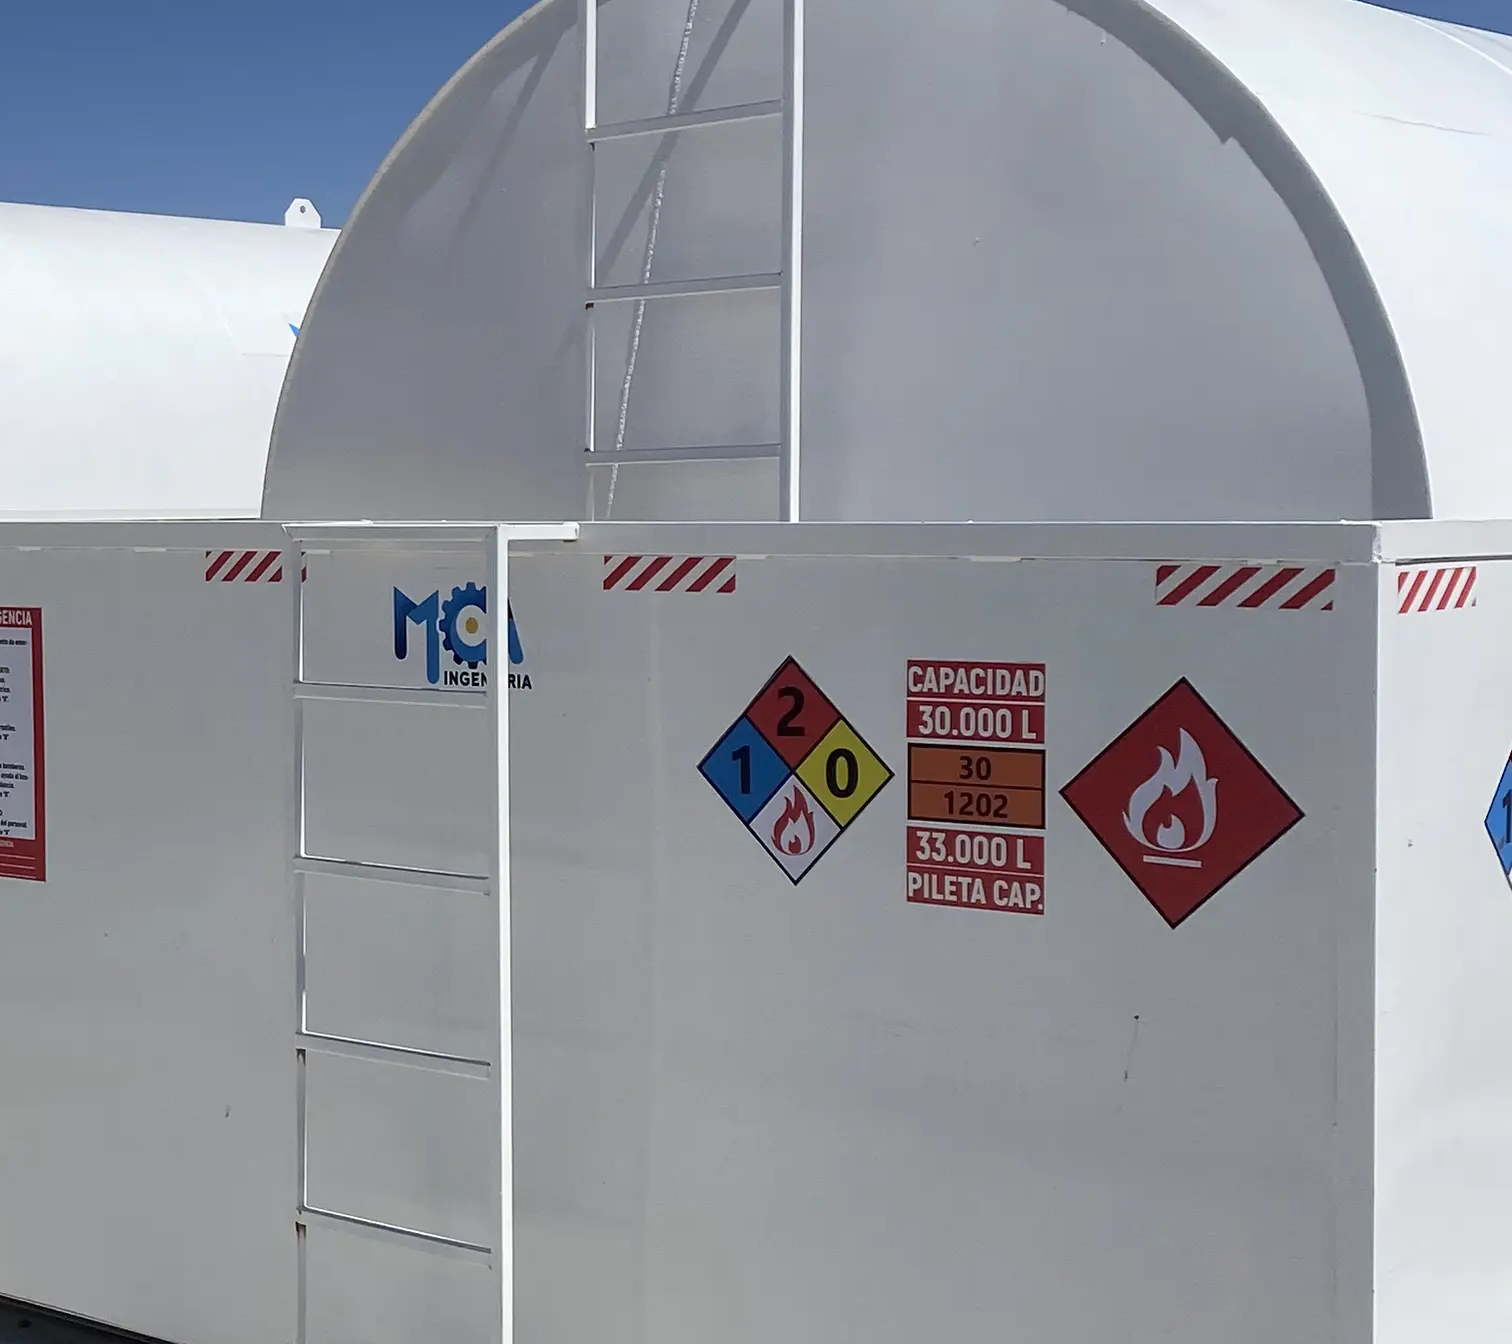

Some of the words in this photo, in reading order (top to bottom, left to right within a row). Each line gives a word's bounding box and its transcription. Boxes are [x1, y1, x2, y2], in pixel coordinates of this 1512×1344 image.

[908, 665, 1044, 697] CAPACIDAD
[777, 686, 805, 736] 2
[919, 705, 1012, 738] 30.000
[1022, 709, 1036, 740] L
[732, 745, 750, 794] 1
[826, 748, 858, 798] 0
[959, 756, 992, 781] 30
[944, 790, 1008, 819] 1202
[916, 831, 1007, 867] 33.000
[1017, 839, 1031, 869] L
[908, 872, 986, 904] PILETA
[993, 879, 1043, 910] CAP.
